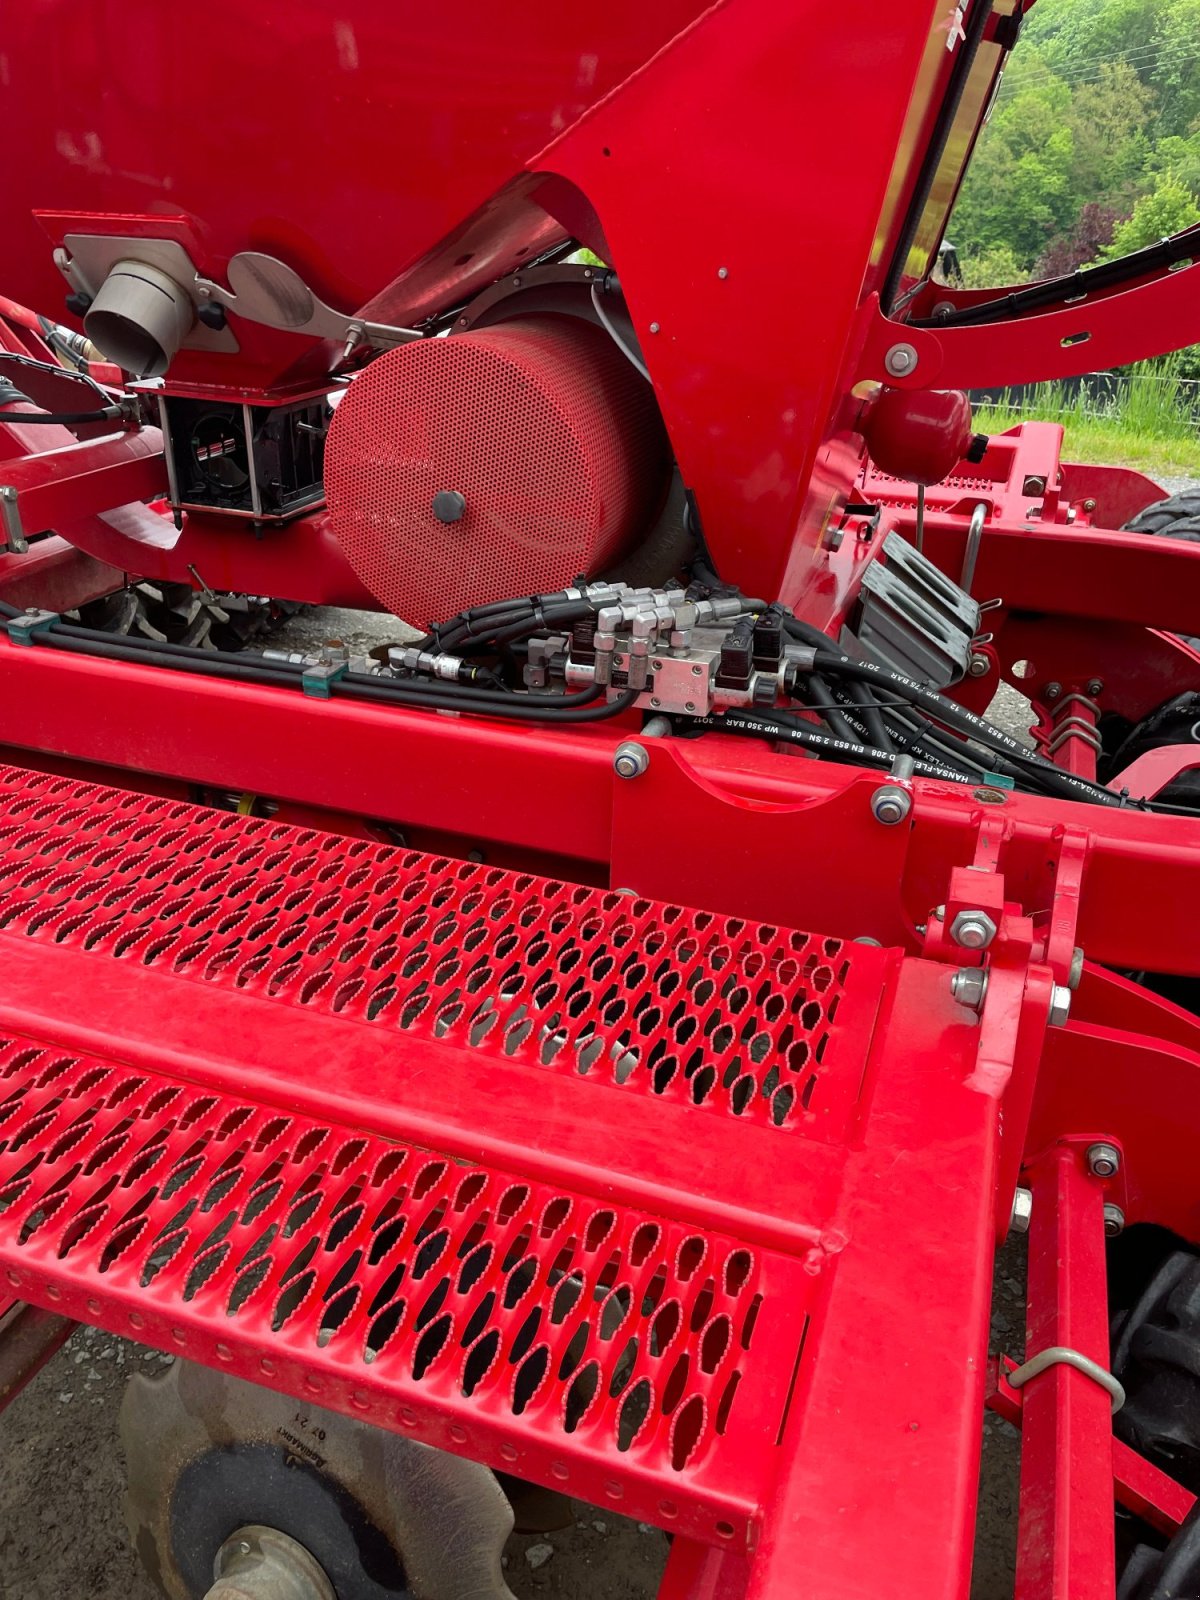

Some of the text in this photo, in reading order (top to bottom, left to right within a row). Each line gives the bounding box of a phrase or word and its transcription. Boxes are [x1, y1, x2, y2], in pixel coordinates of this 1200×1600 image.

[890, 672, 910, 685] BAR
[949, 703, 960, 712] 12
[965, 712, 979, 723] SN
[726, 718, 746, 728] BAR
[747, 722, 763, 731] 350
[978, 720, 986, 728] 2
[764, 725, 779, 734] WP
[791, 730, 802, 738] 08
[987, 727, 1002, 739] 853
[808, 734, 822, 743] SN
[1003, 738, 1017, 748] EN
[833, 740, 849, 749] 853
[851, 744, 865, 753] EN
[871, 749, 888, 759] 208
[913, 759, 969, 783] HANSA-FLE
